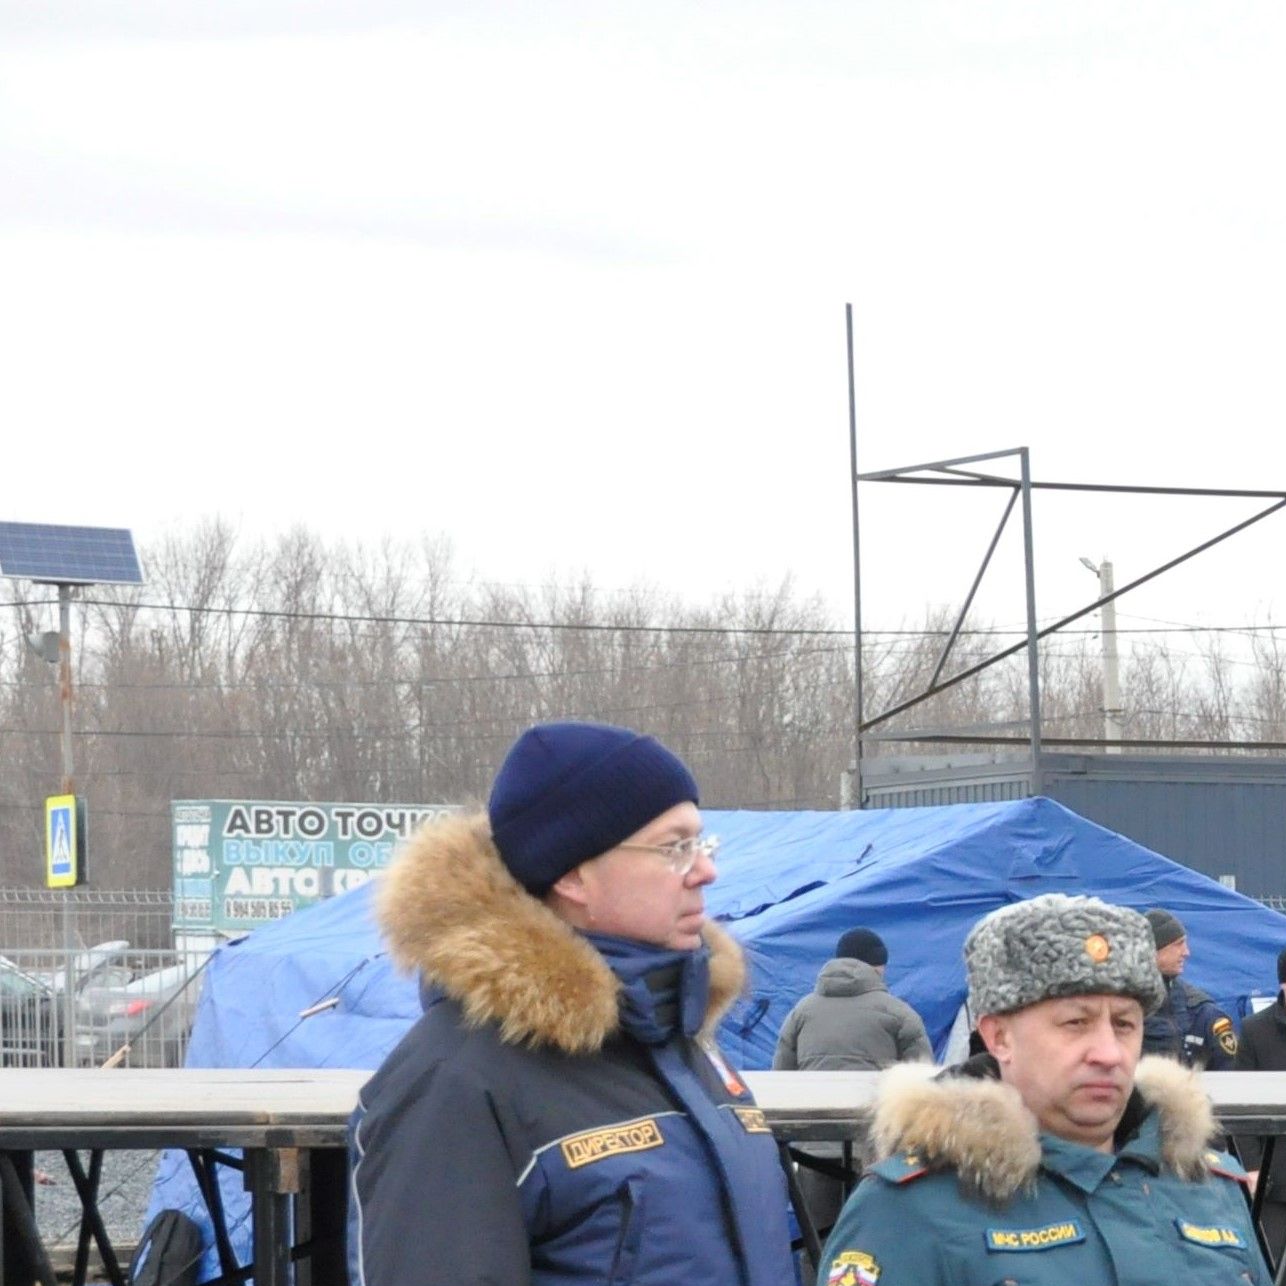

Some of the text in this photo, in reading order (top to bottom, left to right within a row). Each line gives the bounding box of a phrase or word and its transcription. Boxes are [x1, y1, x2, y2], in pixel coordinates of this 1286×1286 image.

[224, 806, 326, 838] АВТО
[332, 809, 448, 840] ТОЧК
[223, 840, 334, 867] ВЫКУП
[349, 842, 396, 868] ОБ
[224, 866, 319, 896] АВТО
[570, 1124, 653, 1160] ДИРЕКТОР
[1022, 1223, 1077, 1246] РОССИИ
